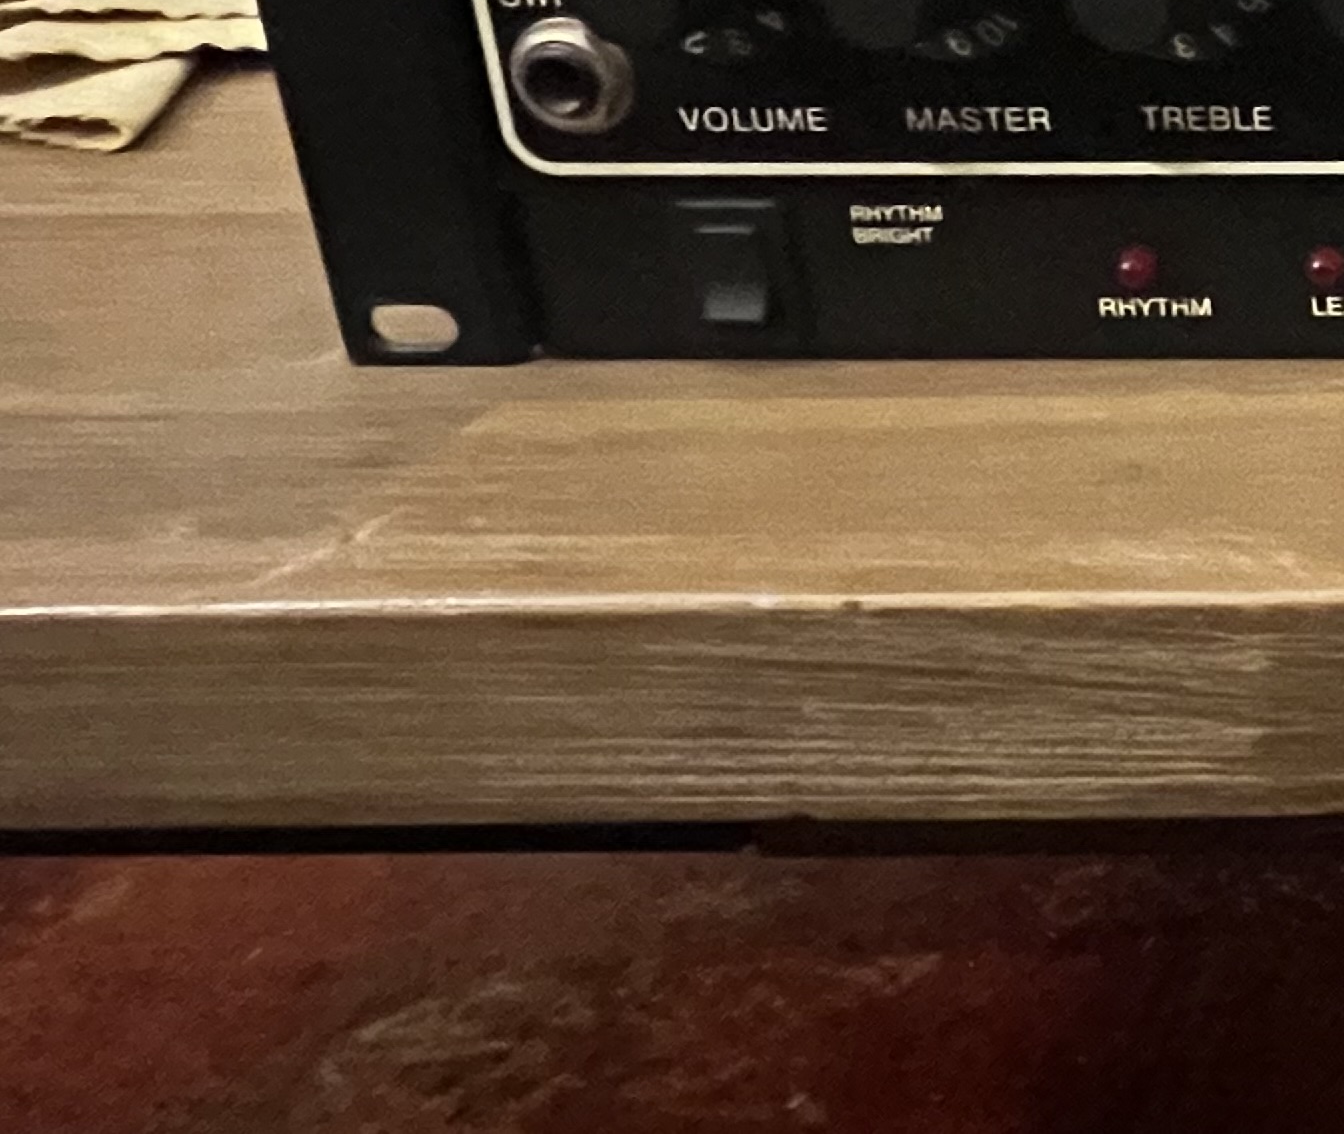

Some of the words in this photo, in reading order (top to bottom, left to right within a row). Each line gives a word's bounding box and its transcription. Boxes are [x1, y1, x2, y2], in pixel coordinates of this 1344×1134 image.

[678, 106, 829, 132] VOLUME
[905, 106, 1053, 132] MASTER
[1141, 105, 1276, 132] TREBLE
[850, 204, 944, 222] RHYTHM
[852, 227, 934, 244] BRIGHT
[1099, 298, 1212, 317] RHYTHM
